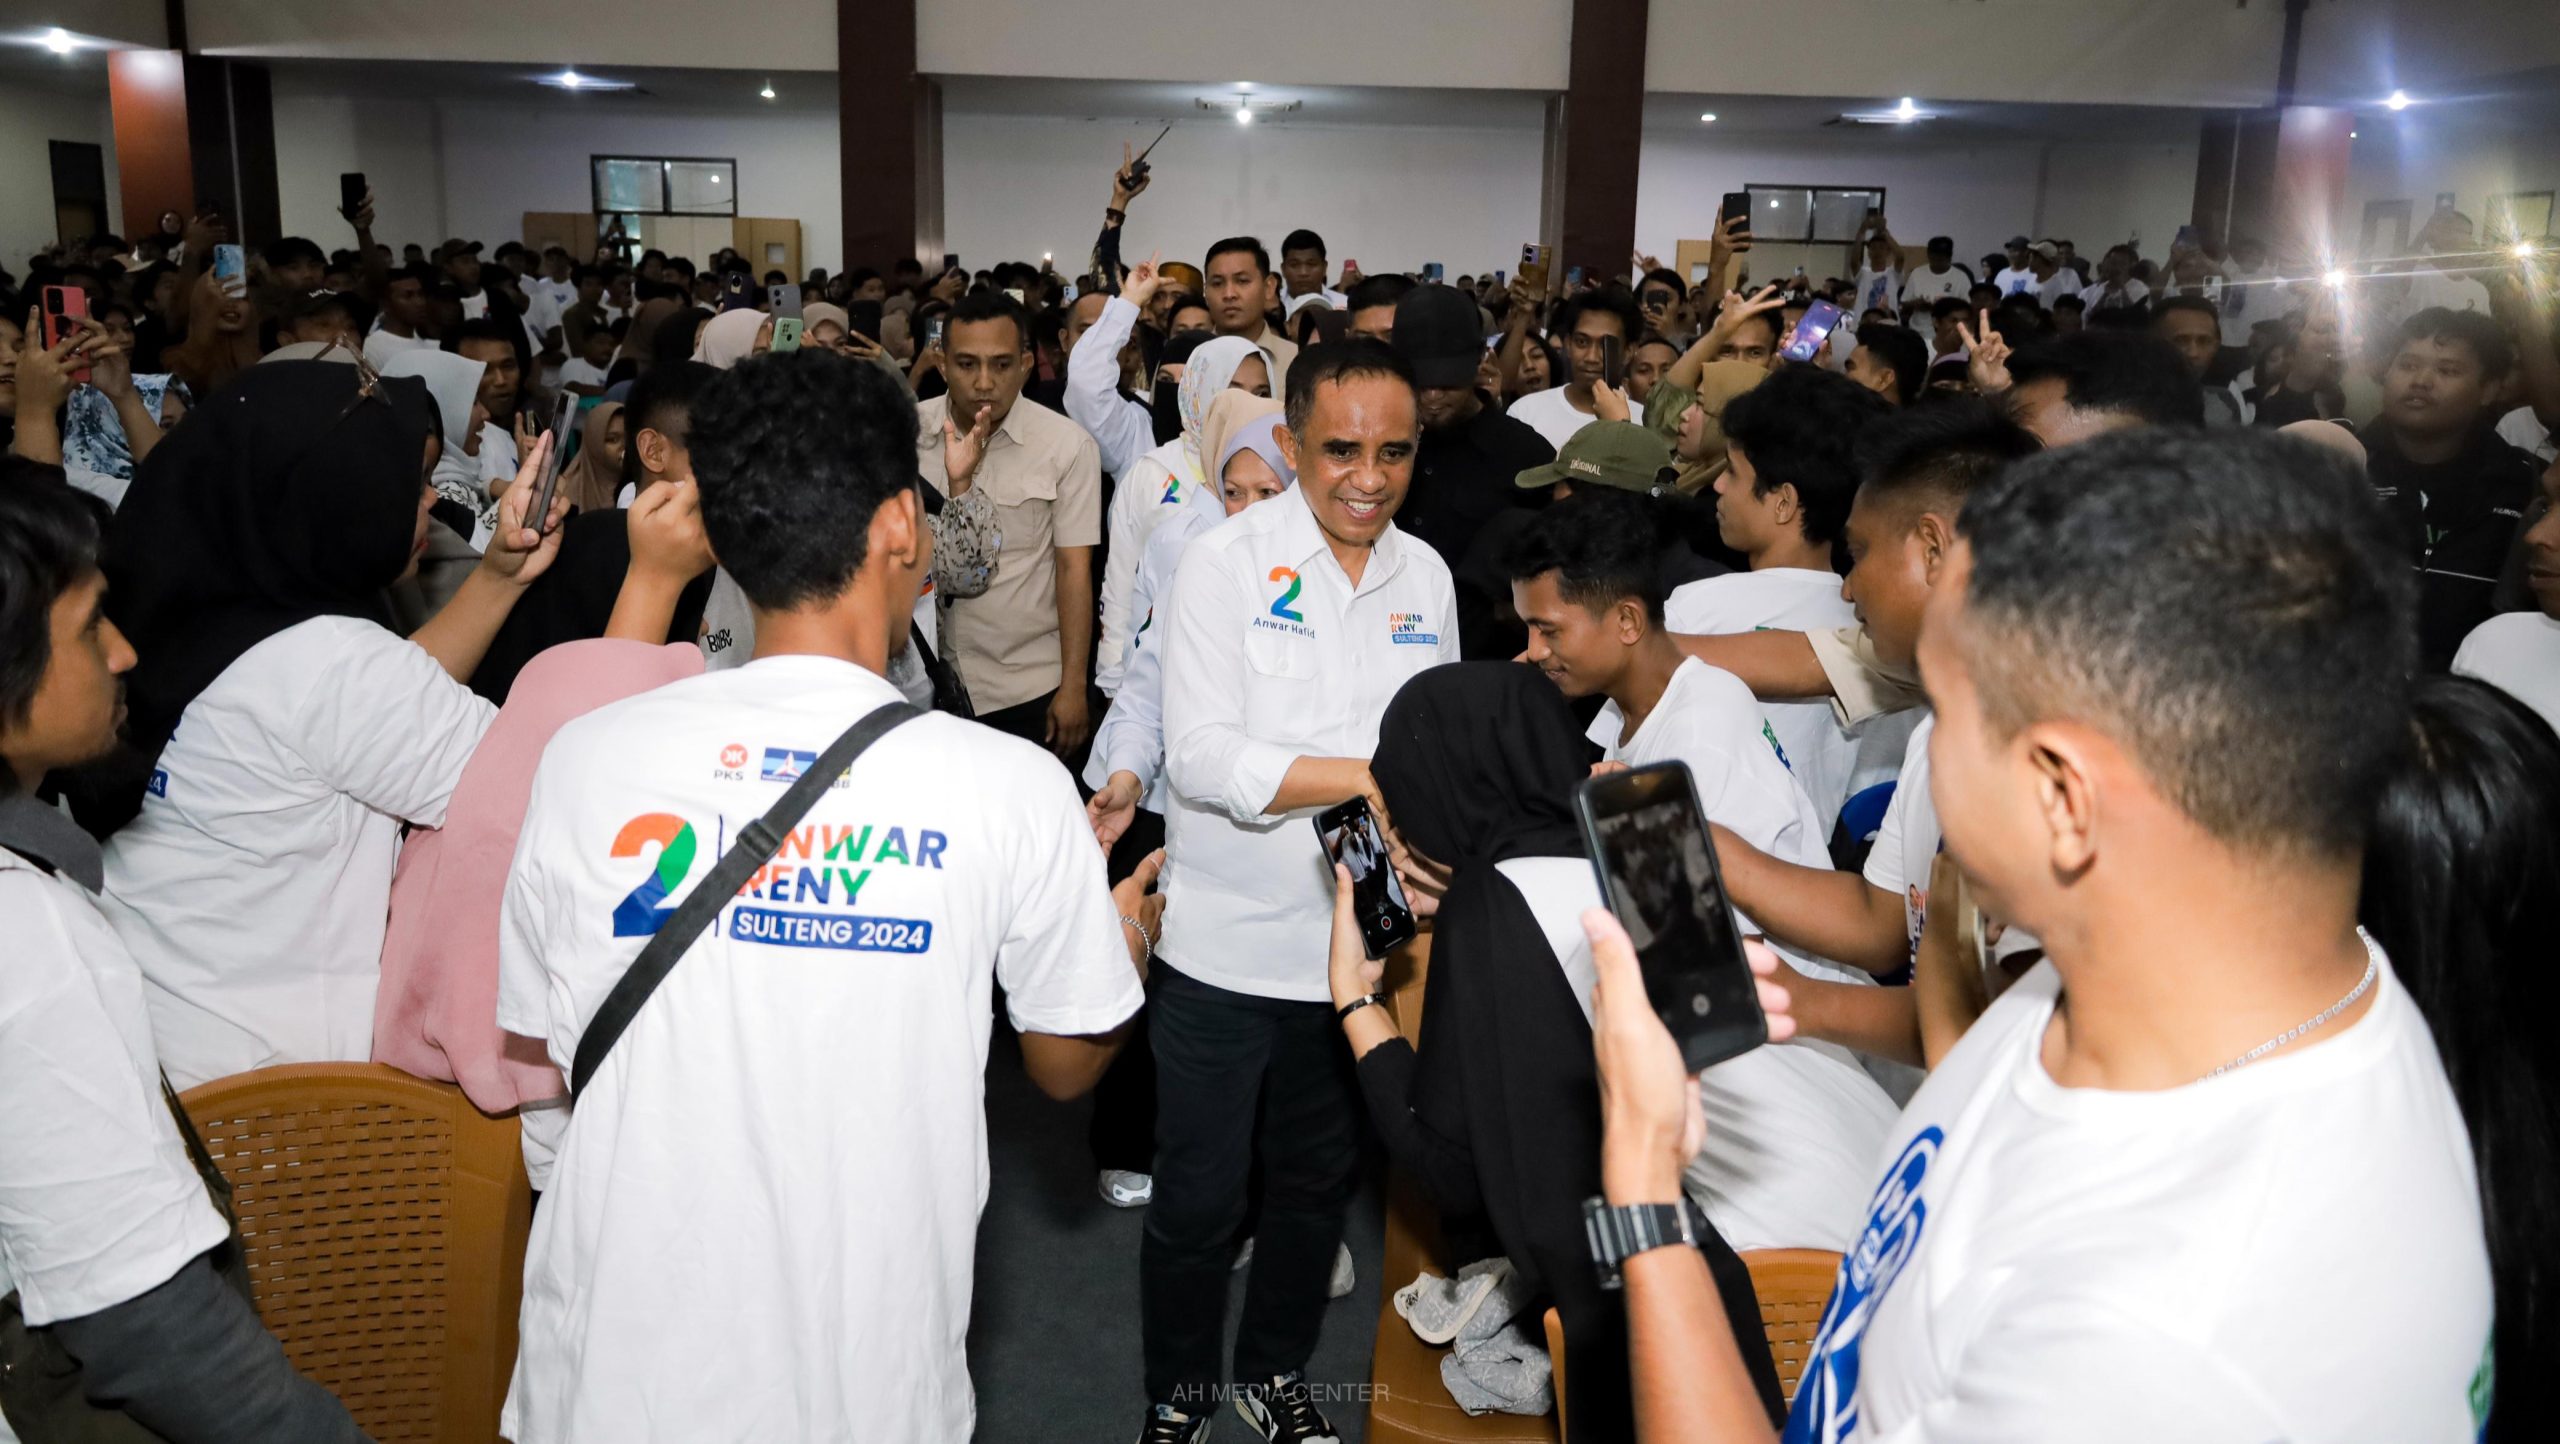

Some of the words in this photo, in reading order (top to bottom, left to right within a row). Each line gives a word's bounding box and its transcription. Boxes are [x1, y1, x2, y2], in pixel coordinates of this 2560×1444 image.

[1268, 566, 1304, 623] 2
[1253, 617, 1289, 632] Anwar
[1291, 624, 1316, 639] Hafid
[1390, 613, 1423, 623] ANWAR
[1391, 624, 1415, 633] RENY
[714, 769, 744, 781] PKS
[776, 823, 948, 870] NWAR
[609, 812, 698, 938] 2
[736, 863, 872, 906] RENY
[737, 912, 853, 944] SULTENG
[857, 922, 925, 949] 2024
